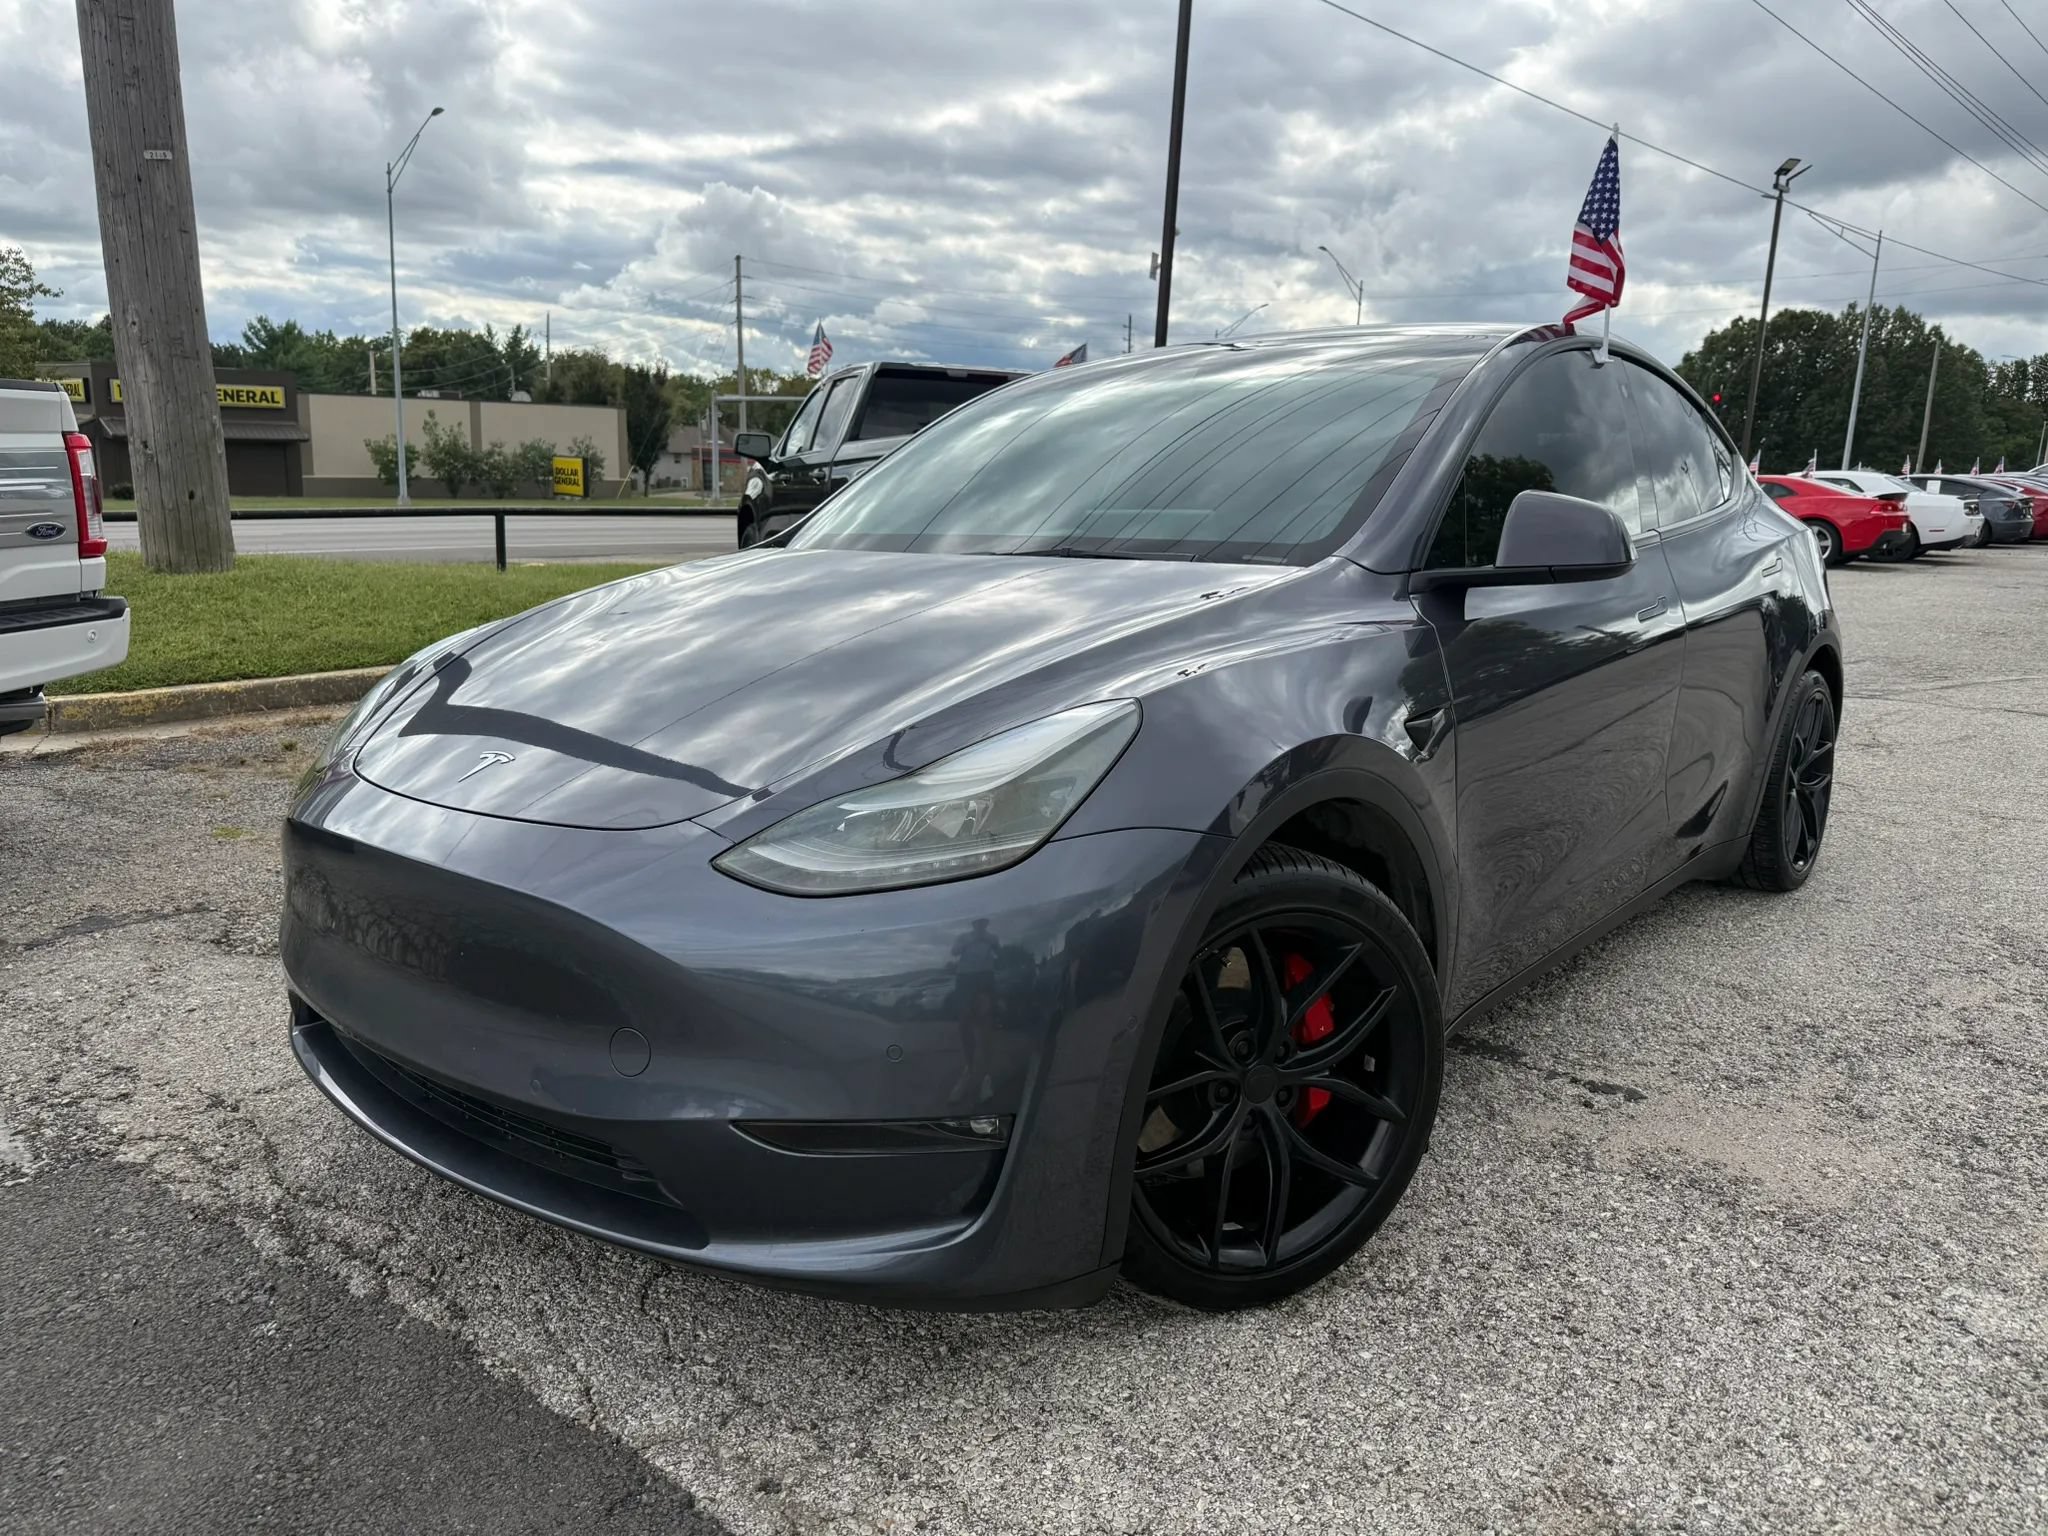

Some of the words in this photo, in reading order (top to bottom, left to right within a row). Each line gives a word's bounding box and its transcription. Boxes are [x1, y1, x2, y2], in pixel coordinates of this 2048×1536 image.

[216, 388, 281, 404] ENERAL
[555, 467, 579, 477] DOLLAR
[554, 476, 581, 487] GENERAL
[36, 526, 58, 536] Ford
